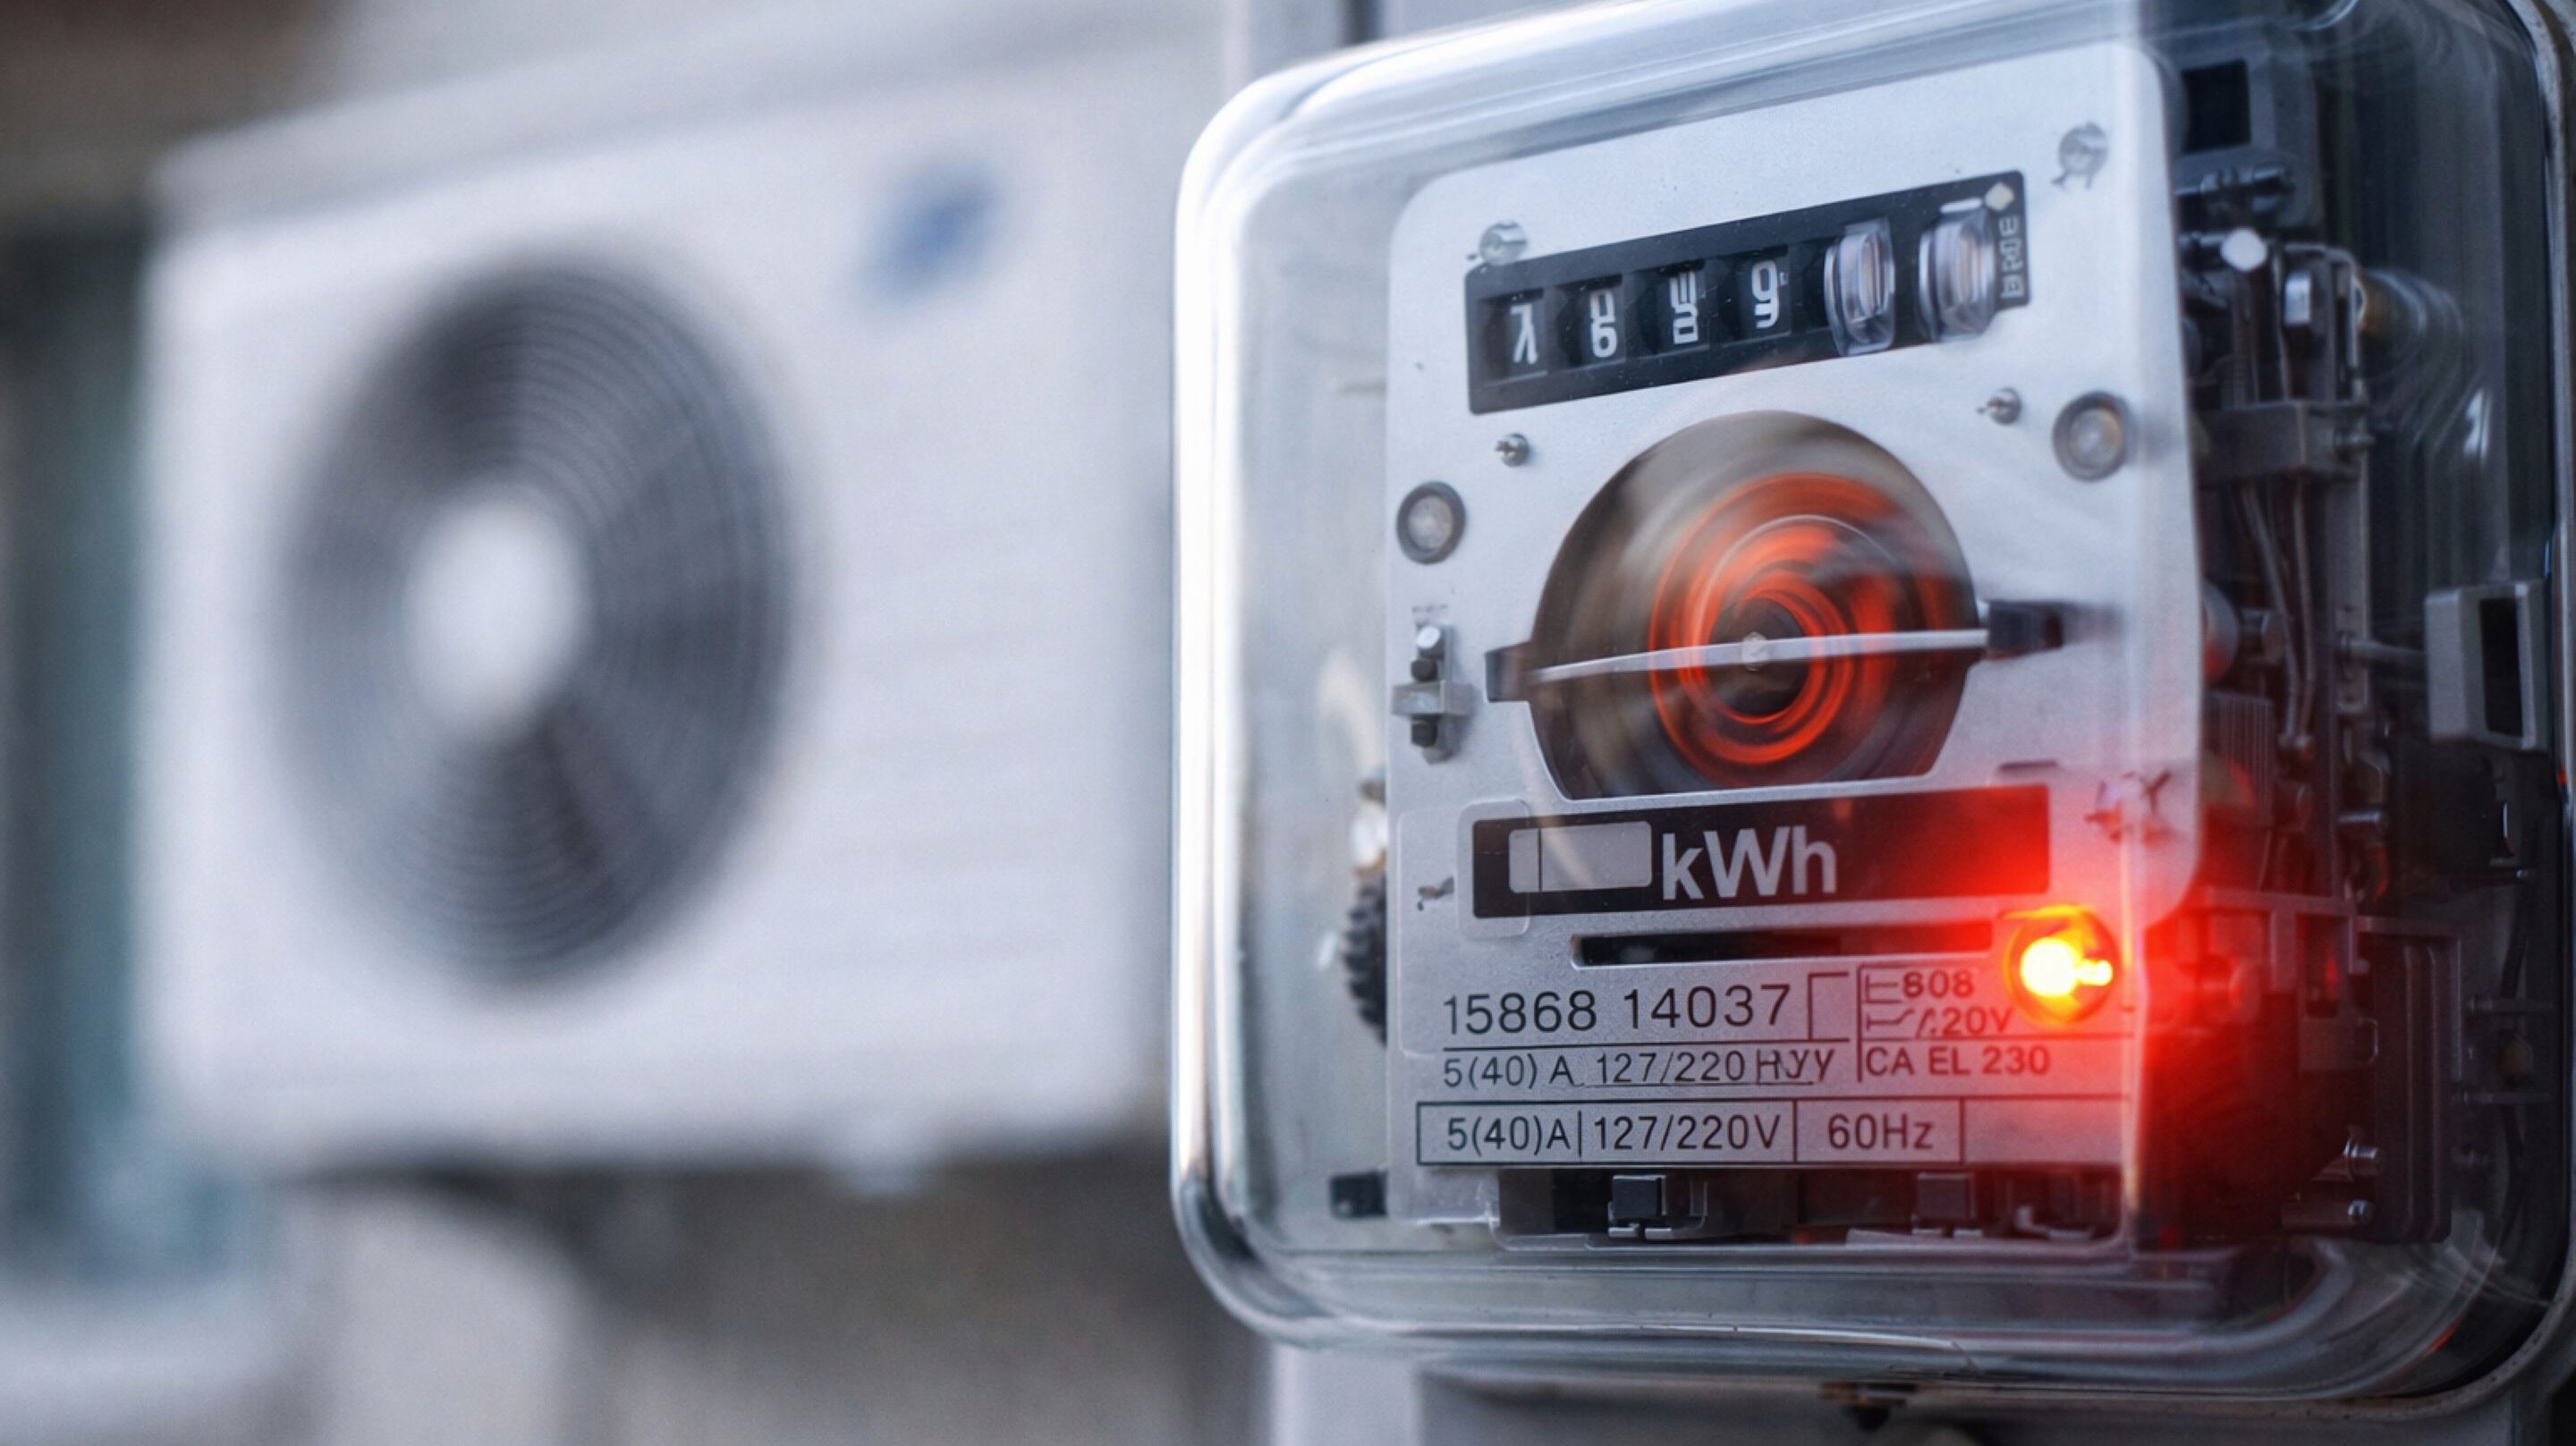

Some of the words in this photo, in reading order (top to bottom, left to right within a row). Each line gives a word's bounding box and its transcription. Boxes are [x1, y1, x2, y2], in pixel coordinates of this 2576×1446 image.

[1662, 824, 1836, 900] kWh
[1444, 990, 1597, 1035] 15868
[1623, 984, 1790, 1029] 14037
[1444, 1053, 1537, 1088] 5(40)
[1597, 1050, 1745, 1084] 127/220
[1866, 1047, 1913, 1075] CA
[1928, 1046, 1971, 1074] EL
[1981, 1045, 2050, 1072] 230
[1447, 1114, 1571, 1155] 5(40)A
[1594, 1114, 1780, 1152] 127/220V
[1827, 1114, 1934, 1150] 60Hz
